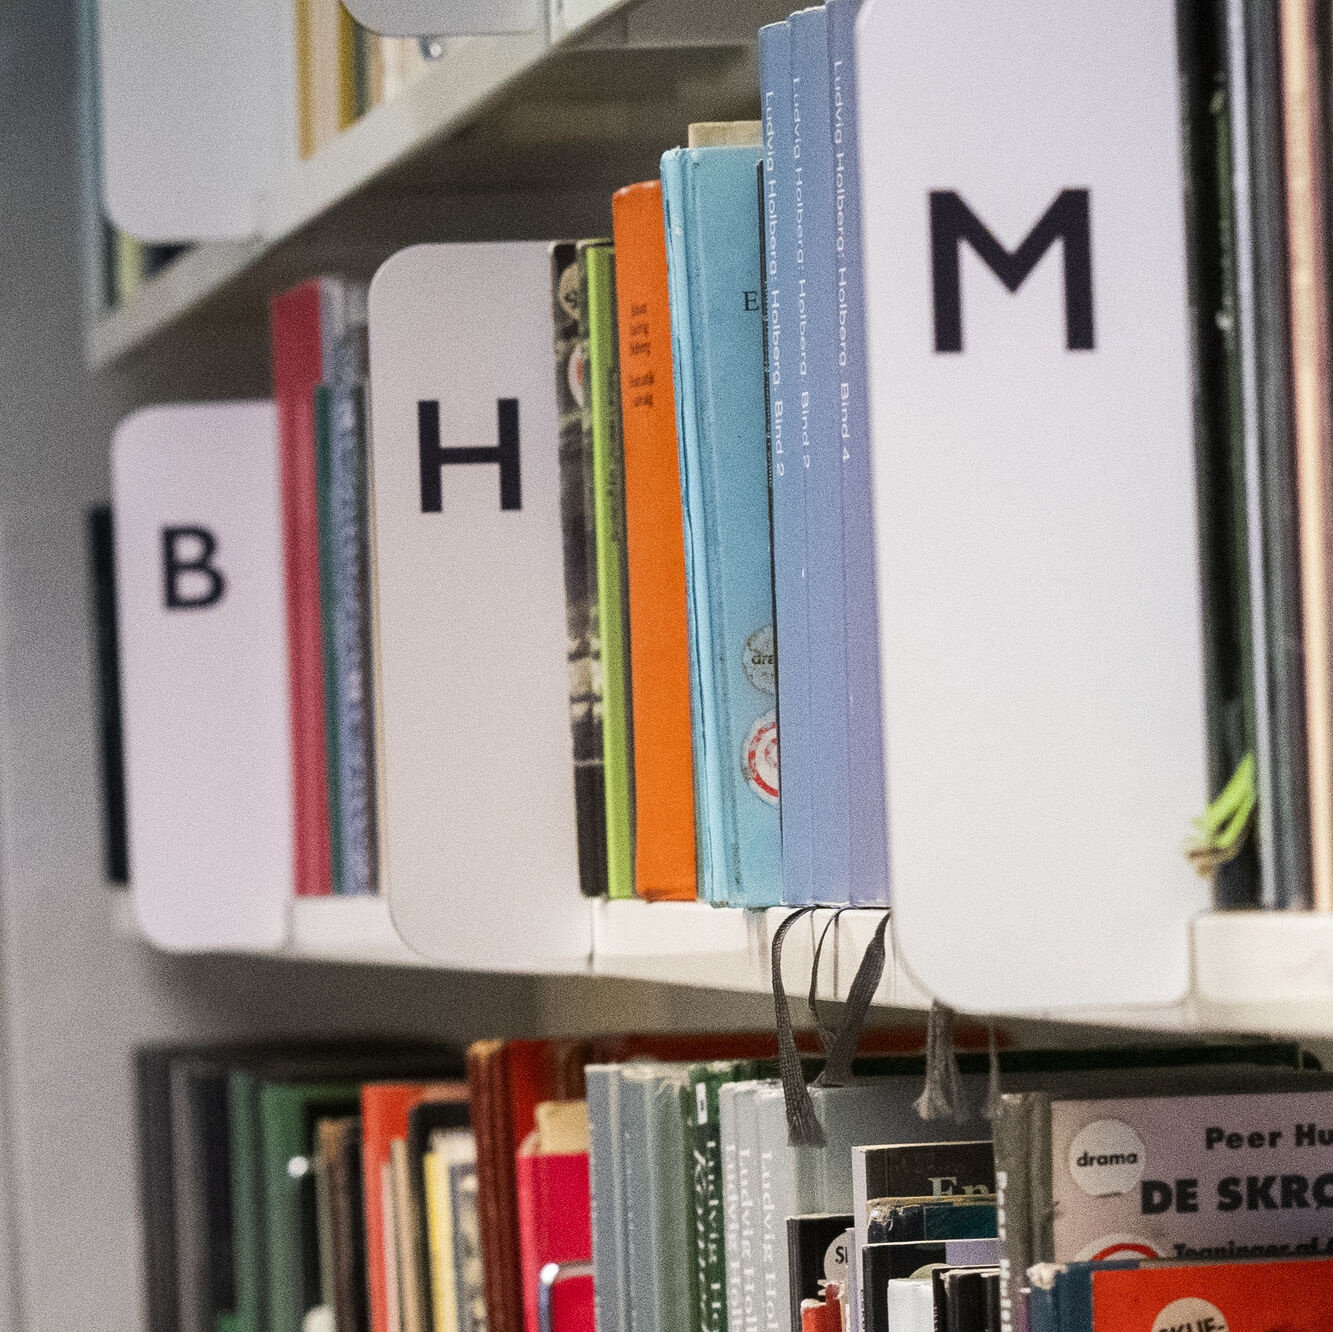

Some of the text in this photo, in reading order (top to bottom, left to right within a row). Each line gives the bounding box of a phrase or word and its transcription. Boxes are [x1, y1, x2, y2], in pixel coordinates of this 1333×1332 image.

[766, 90, 775, 172] Ludvig
[793, 77, 802, 159] Ludvig
[834, 60, 844, 144] Ludvig
[928, 187, 1096, 353] M
[775, 400, 784, 455] Bind
[801, 391, 810, 447] Bind
[841, 382, 850, 439] Bind
[417, 398, 523, 514] H
[777, 463, 785, 477] 2
[803, 454, 811, 469] 2
[843, 447, 851, 463] 4
[161, 524, 229, 612] B
[1076, 1151, 1138, 1169] drama
[1205, 1126, 1283, 1151] Peer
[740, 1149, 753, 1258] Ludvig
[761, 1151, 775, 1263] Ludvig
[996, 1170, 1008, 1242] Peer
[1140, 1177, 1200, 1214] DE
